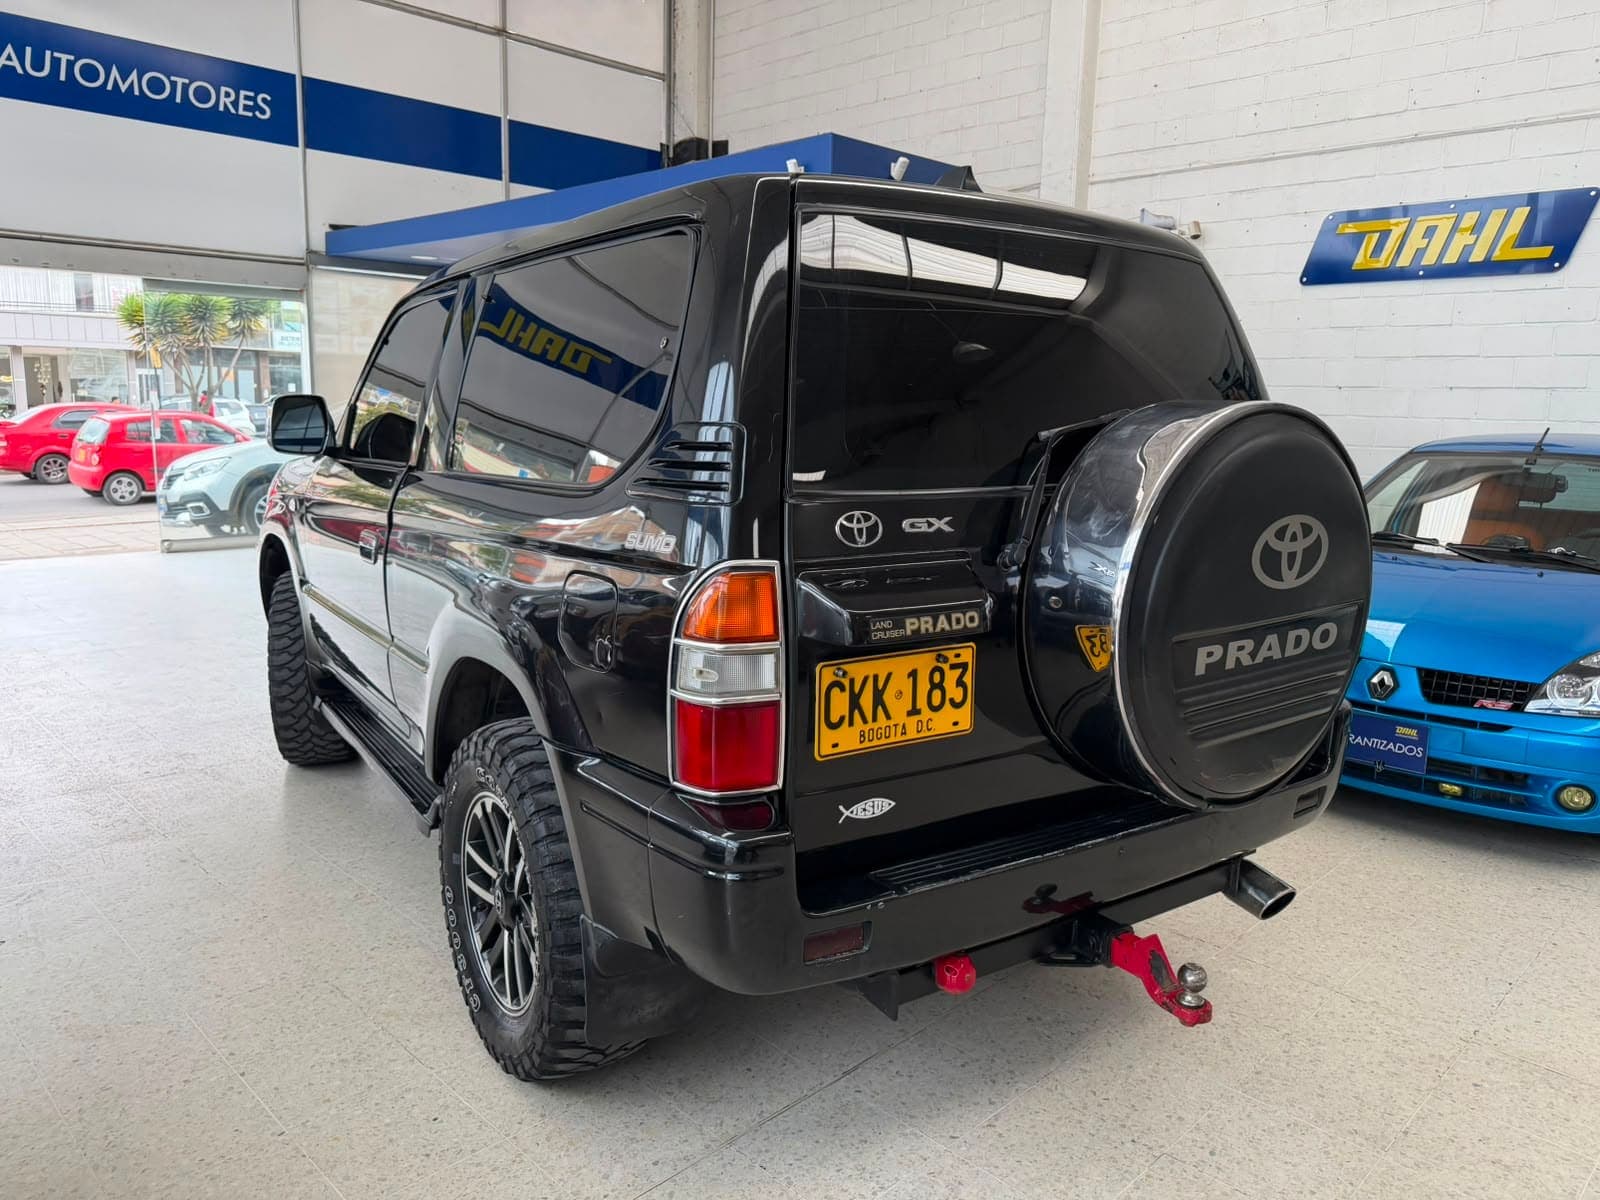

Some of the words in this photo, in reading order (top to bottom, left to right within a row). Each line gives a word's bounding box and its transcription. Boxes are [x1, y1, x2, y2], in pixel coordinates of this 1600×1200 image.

[0, 43, 272, 120] AUTOMOTORES
[1336, 206, 1554, 270] DAHL
[902, 516, 955, 533] GX
[624, 531, 677, 554] SUMO
[870, 620, 893, 630] LAND
[871, 628, 906, 640] CRUISER
[905, 610, 980, 636] PRADO
[1194, 622, 1338, 676] PRADO
[823, 672, 893, 730] CKK
[906, 661, 969, 718] 183
[859, 721, 907, 744] BOGOTA
[916, 718, 936, 734] D.C.
[1395, 726, 1418, 736] DAHL
